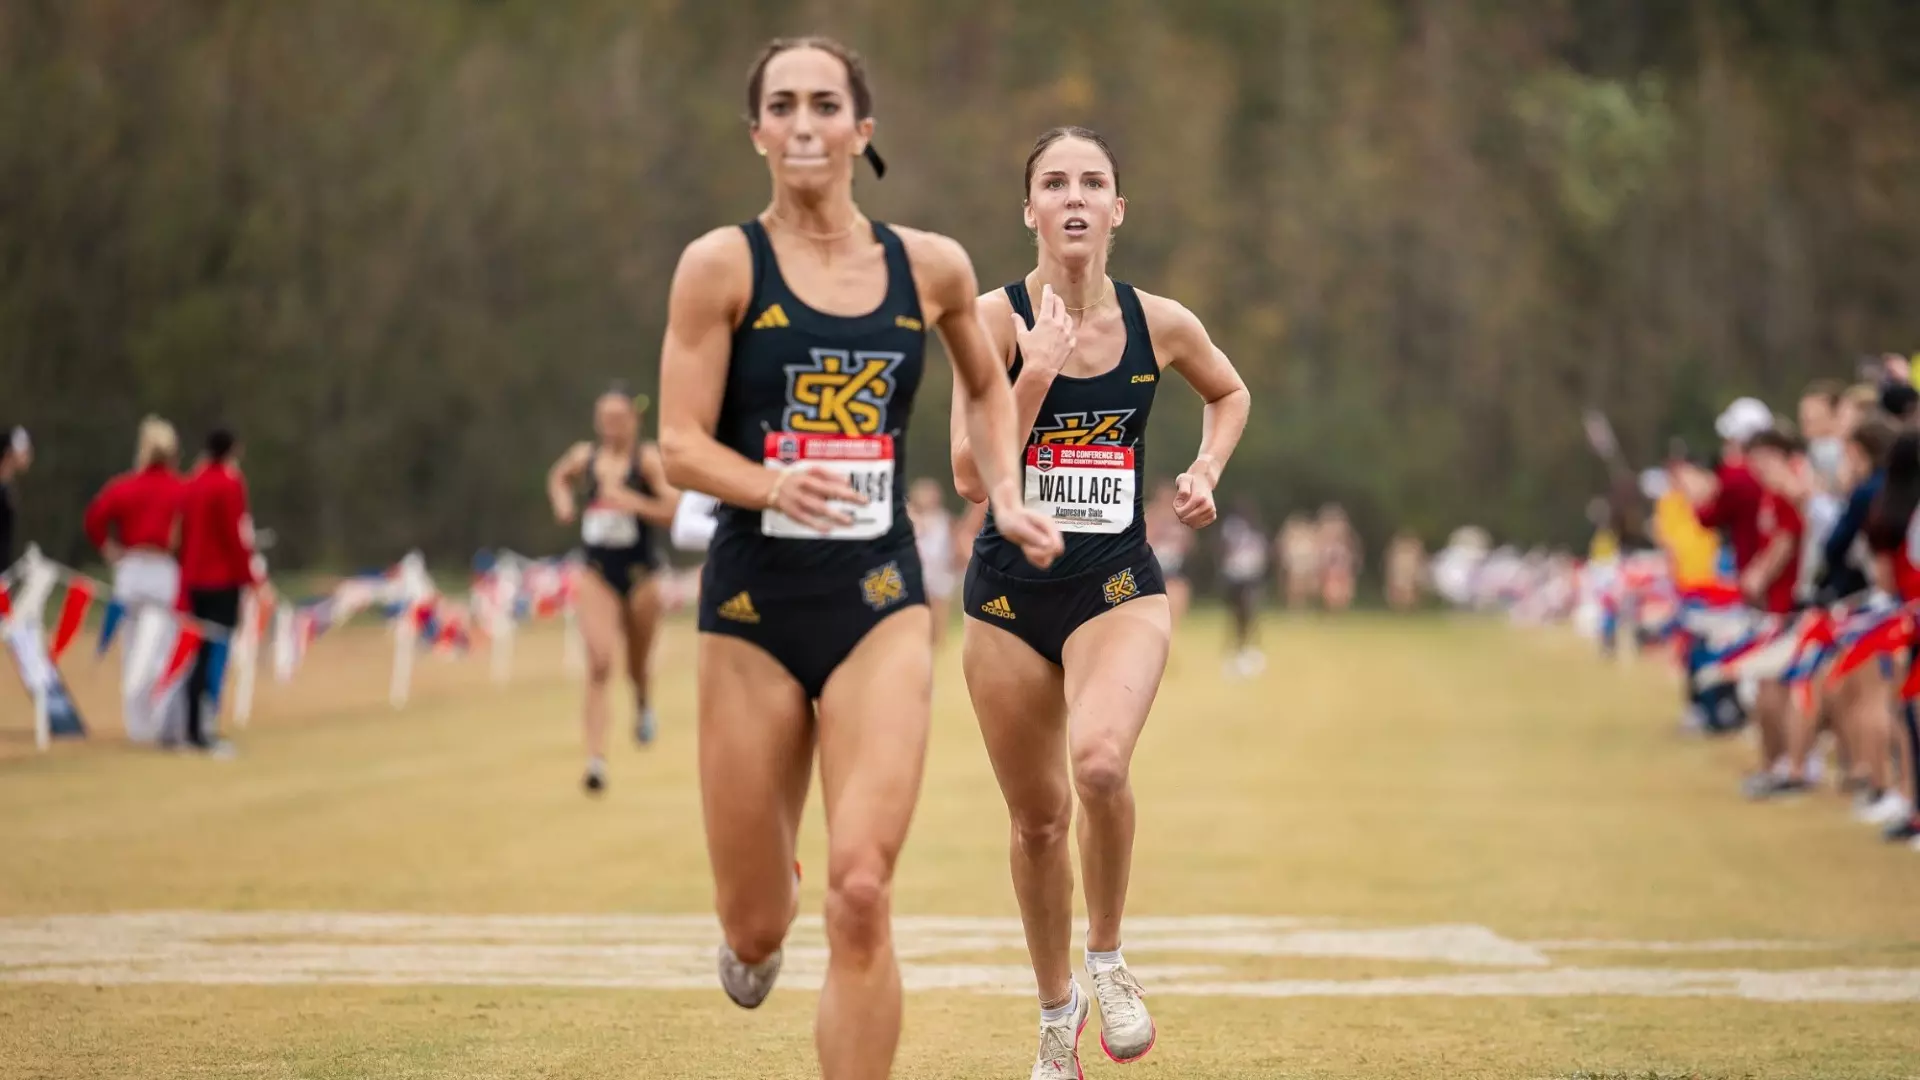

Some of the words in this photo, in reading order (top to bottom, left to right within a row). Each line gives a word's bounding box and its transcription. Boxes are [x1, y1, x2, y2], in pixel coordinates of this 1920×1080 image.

[1060, 449, 1076, 458] 2024
[1076, 450, 1114, 460] CONFERENCE
[1039, 475, 1122, 504] WALLACE
[1055, 506, 1086, 517] Kennesaw
[1088, 508, 1103, 518] State
[981, 604, 1016, 620] adidas
